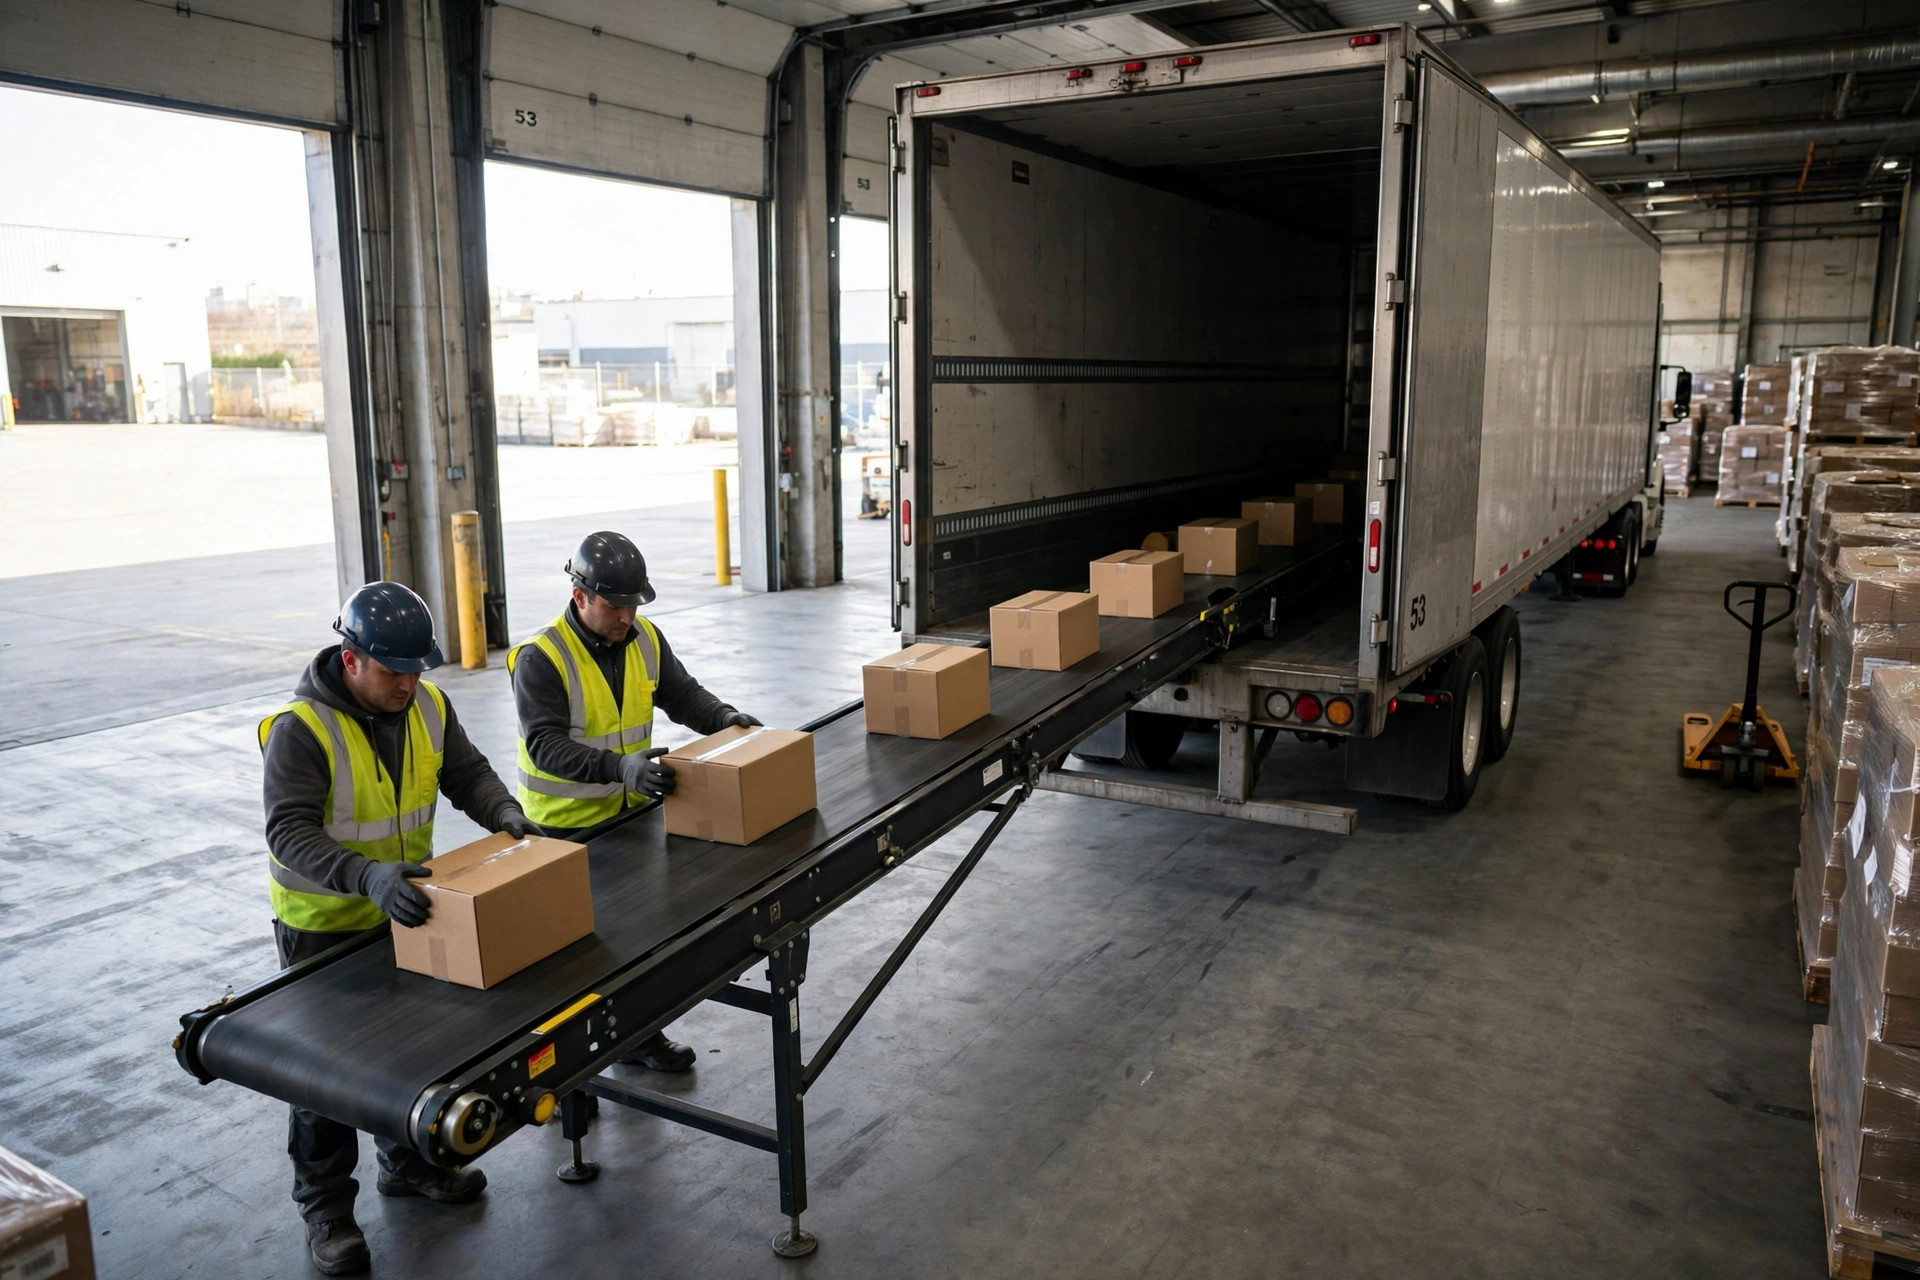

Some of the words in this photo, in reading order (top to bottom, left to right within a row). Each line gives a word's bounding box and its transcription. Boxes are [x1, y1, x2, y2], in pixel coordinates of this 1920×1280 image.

[515, 109, 537, 127] 53
[857, 177, 871, 190] 53
[1410, 594, 1426, 631] 53
